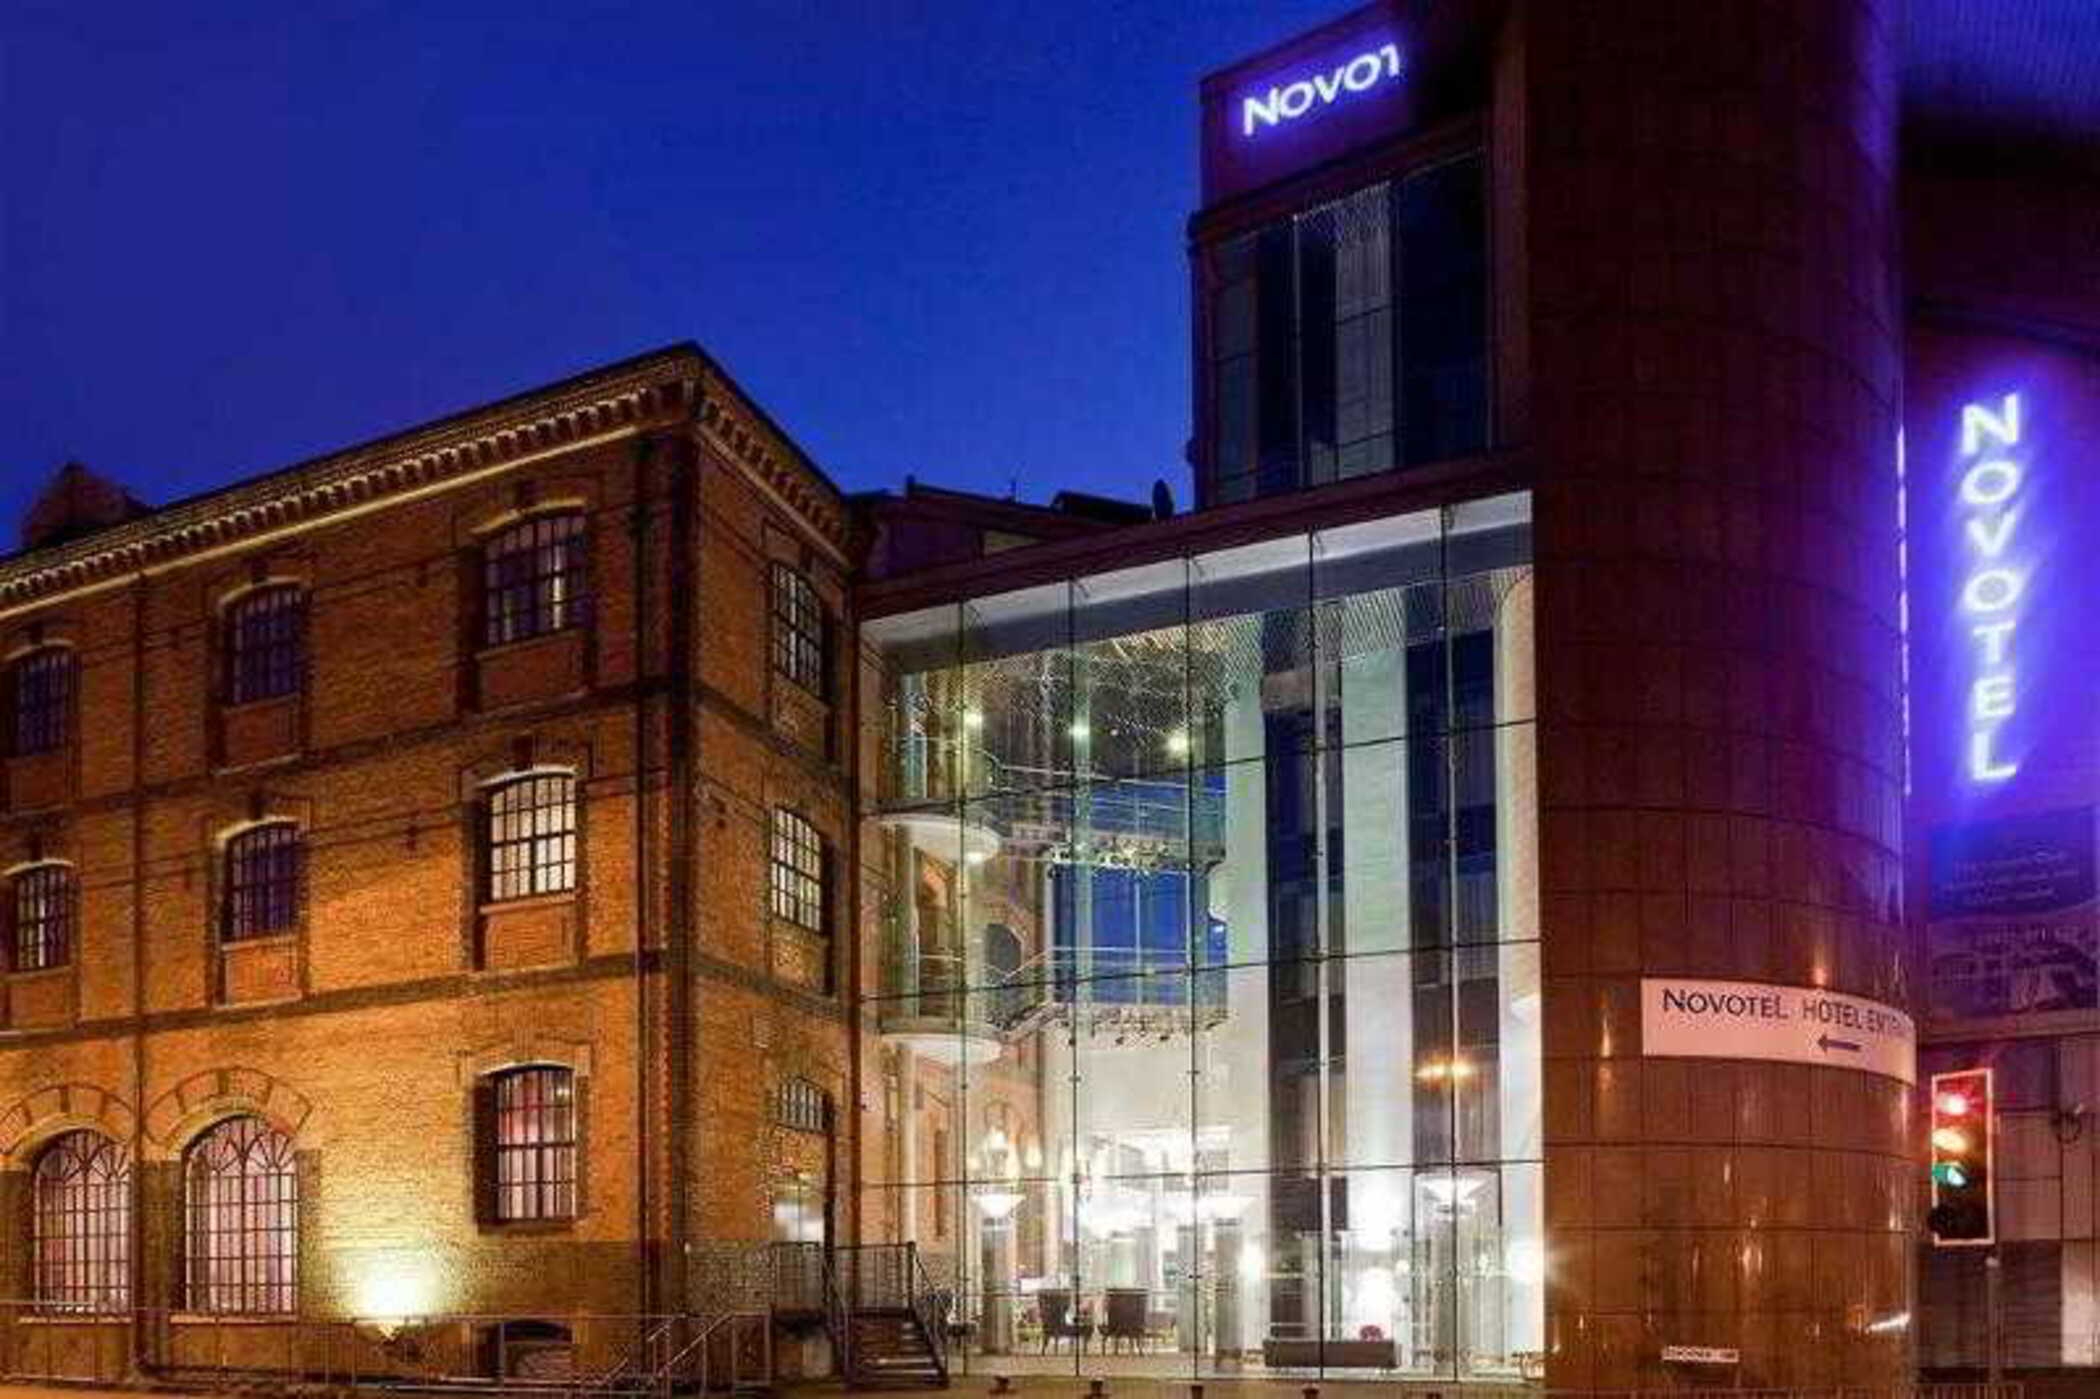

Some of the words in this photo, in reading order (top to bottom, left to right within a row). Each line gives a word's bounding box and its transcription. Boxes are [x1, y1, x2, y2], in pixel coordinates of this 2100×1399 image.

[1961, 392, 2021, 782] NOVOTEL
[1662, 988, 1789, 1020] NOVOTEL
[1802, 998, 1863, 1029] HOTEL
